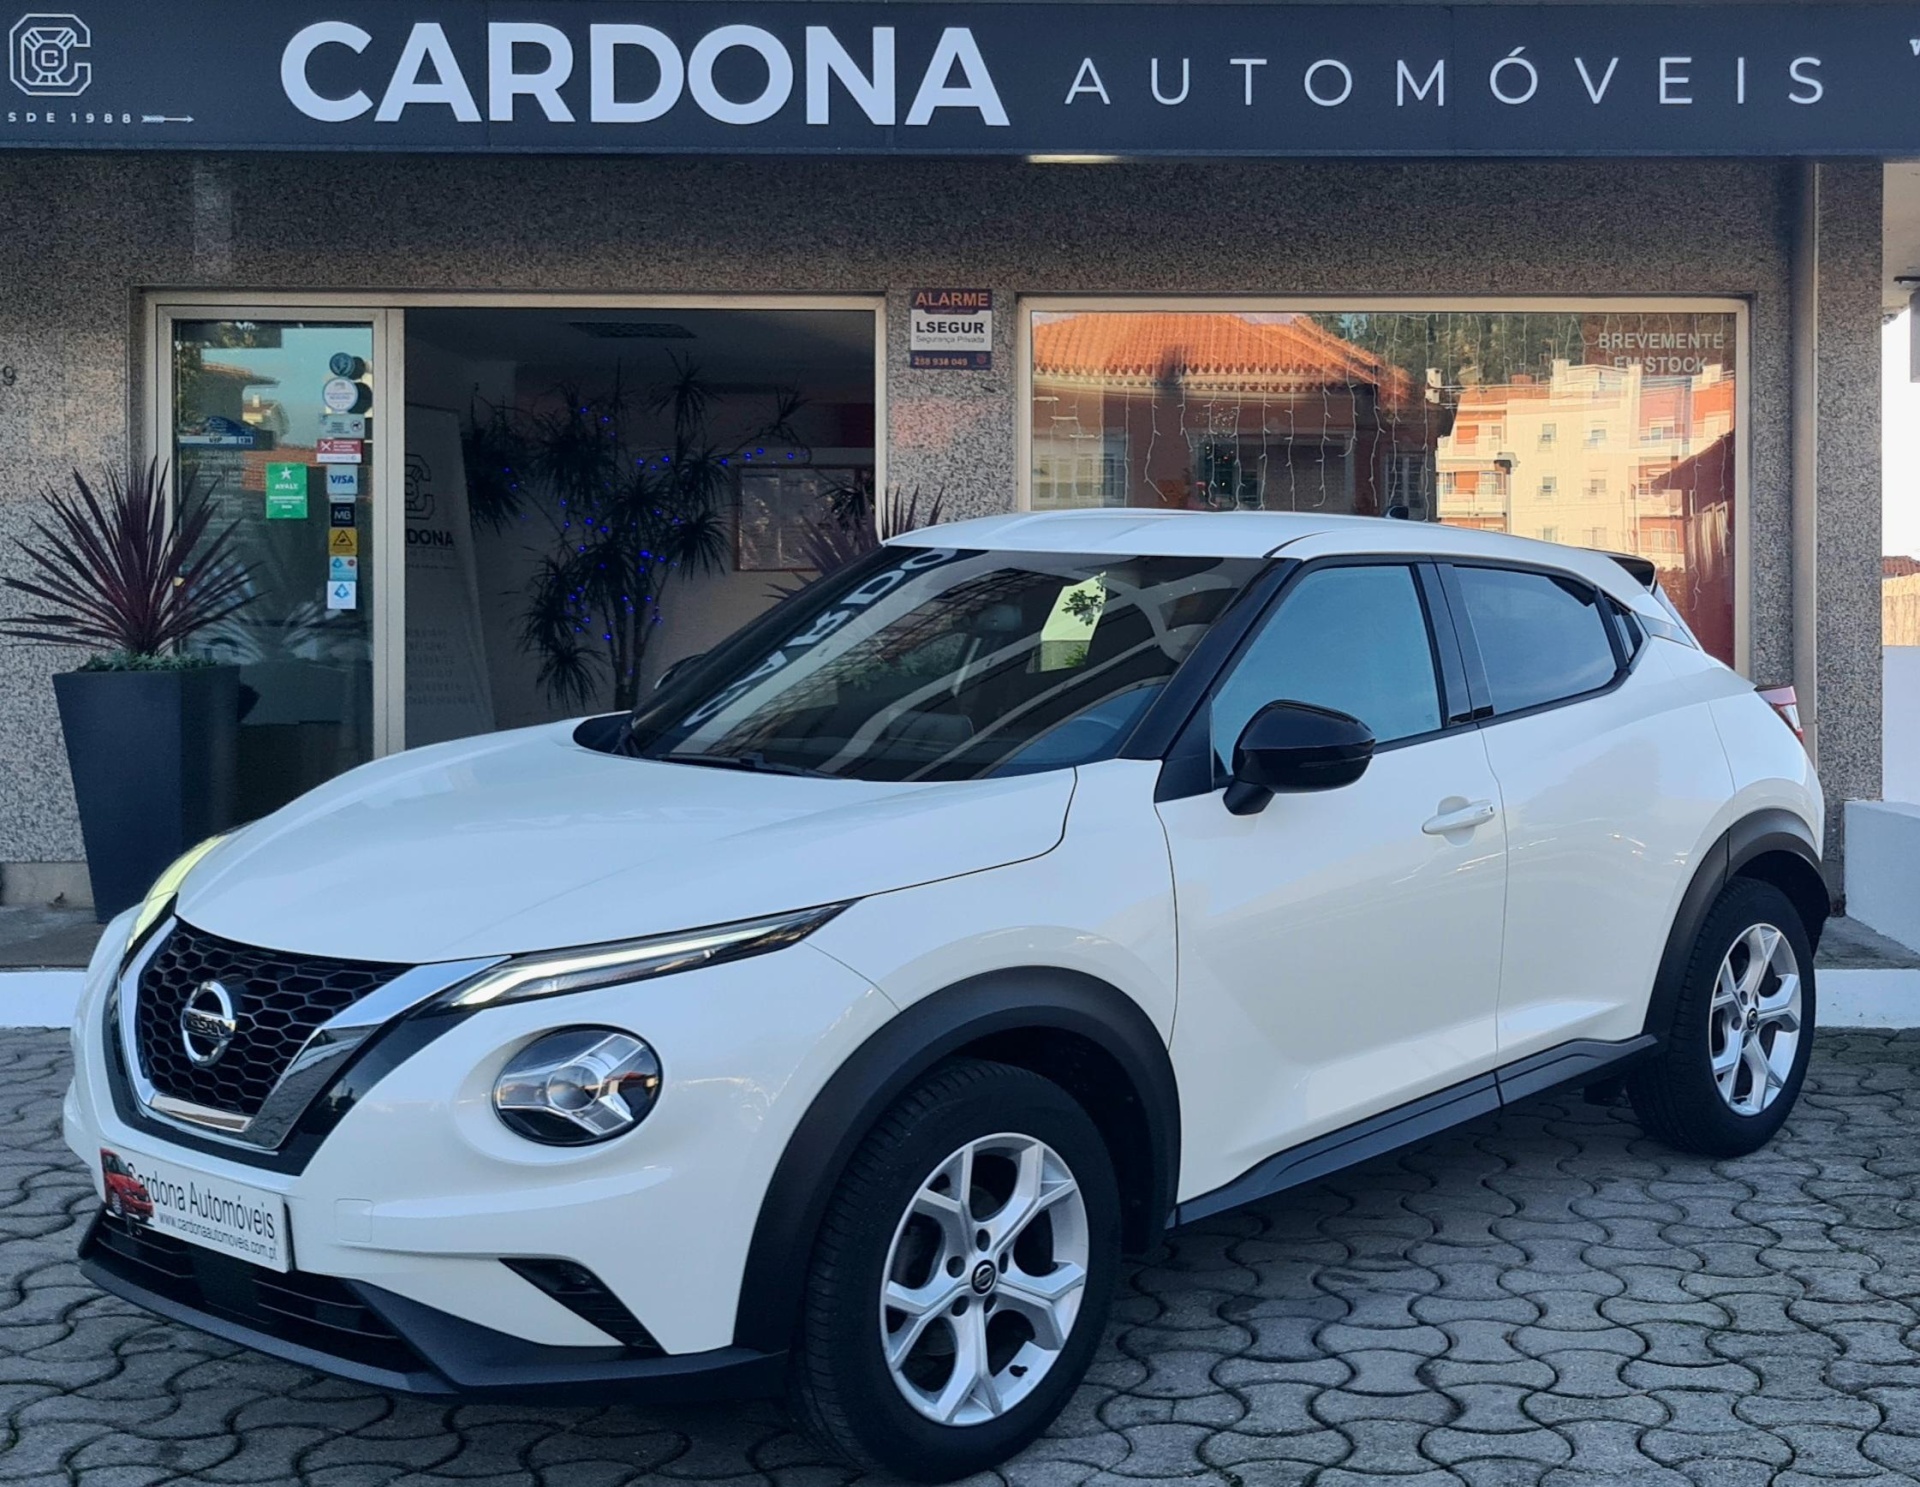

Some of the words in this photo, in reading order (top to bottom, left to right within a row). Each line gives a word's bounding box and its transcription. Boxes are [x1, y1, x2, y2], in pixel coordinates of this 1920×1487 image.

[280, 21, 1011, 126] CARDONA
[1064, 46, 1824, 105] AUTOMÓVEIS
[71, 113, 131, 124] 1988
[915, 292, 989, 307] ALARME
[916, 321, 985, 334] LSEGUR
[1598, 333, 1724, 349] BREVEMENTE
[1645, 356, 1708, 373] STOCK
[330, 475, 355, 484] VISA
[334, 511, 351, 520] MB
[407, 528, 454, 546] DONA
[189, 1182, 275, 1240] Automóveis
